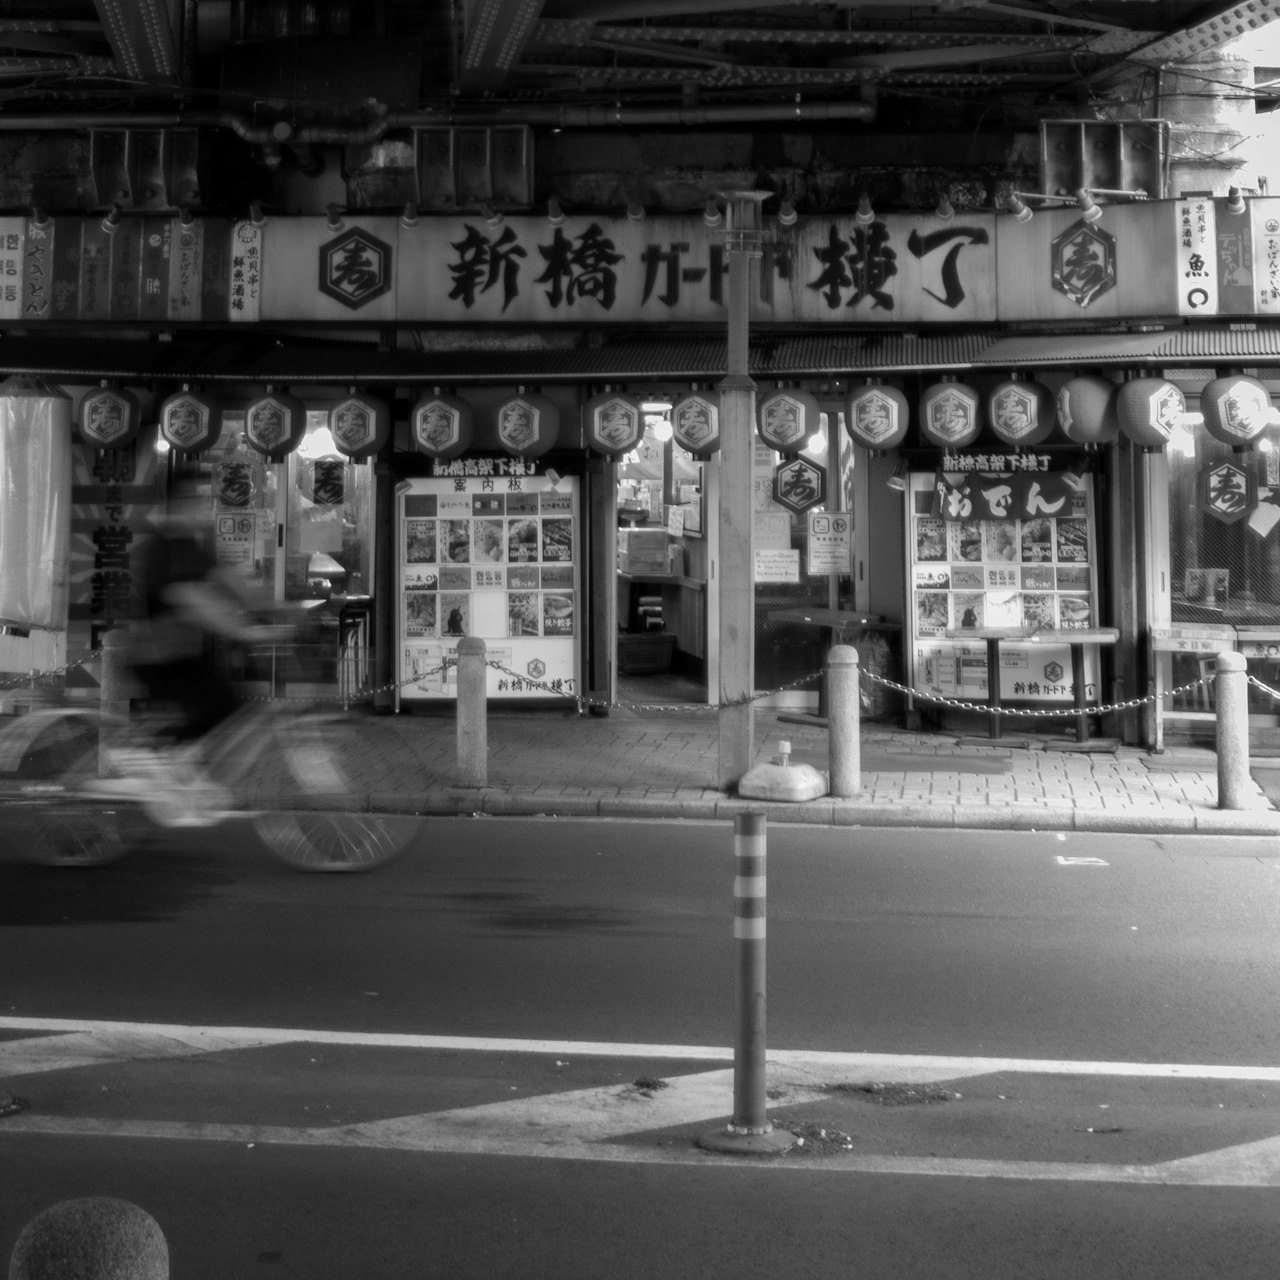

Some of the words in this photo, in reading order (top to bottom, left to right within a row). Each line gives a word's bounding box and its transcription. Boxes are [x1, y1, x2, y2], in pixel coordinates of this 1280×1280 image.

[231, 256, 245, 311] 鮮魚酒場
[943, 453, 1052, 472] 新橋高架下横丁
[454, 476, 523, 493] 案内板
[947, 481, 1066, 518] おでん
[1013, 680, 1097, 696] 新橋ガード下丁
